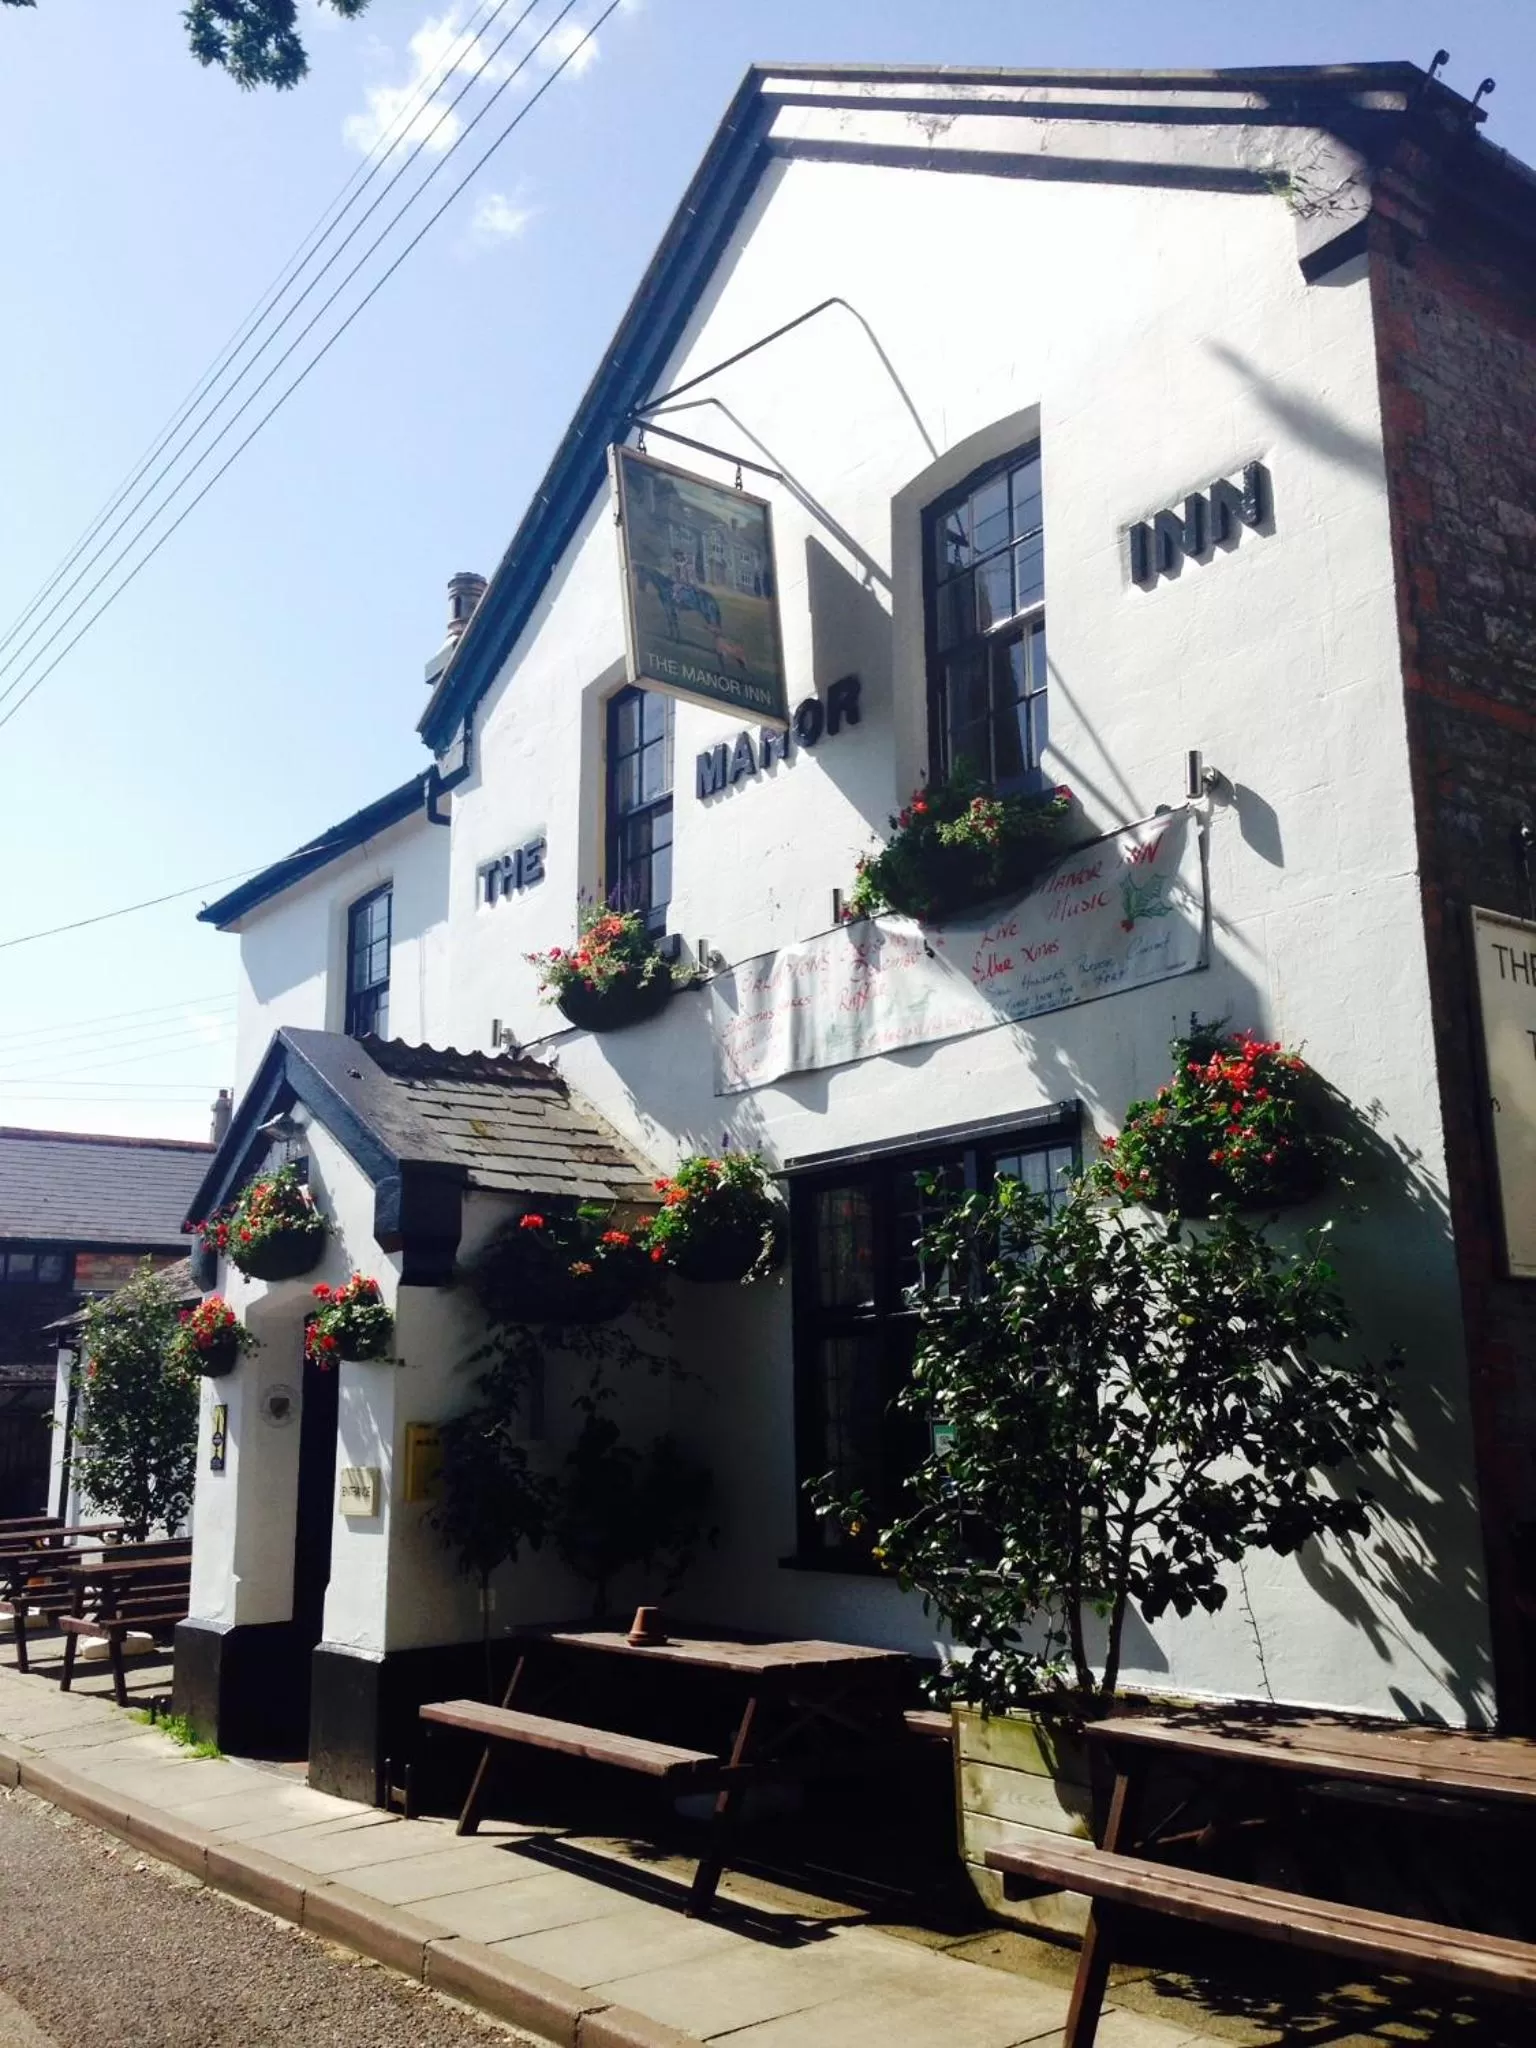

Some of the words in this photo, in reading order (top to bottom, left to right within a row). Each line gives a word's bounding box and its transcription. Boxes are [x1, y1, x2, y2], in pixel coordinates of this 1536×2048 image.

[481, 837, 547, 904] THE
[695, 675, 861, 800] MANOR
[1129, 460, 1268, 586] INN
[648, 653, 679, 676] THE
[682, 665, 741, 696] MANOR
[744, 685, 772, 706] INN
